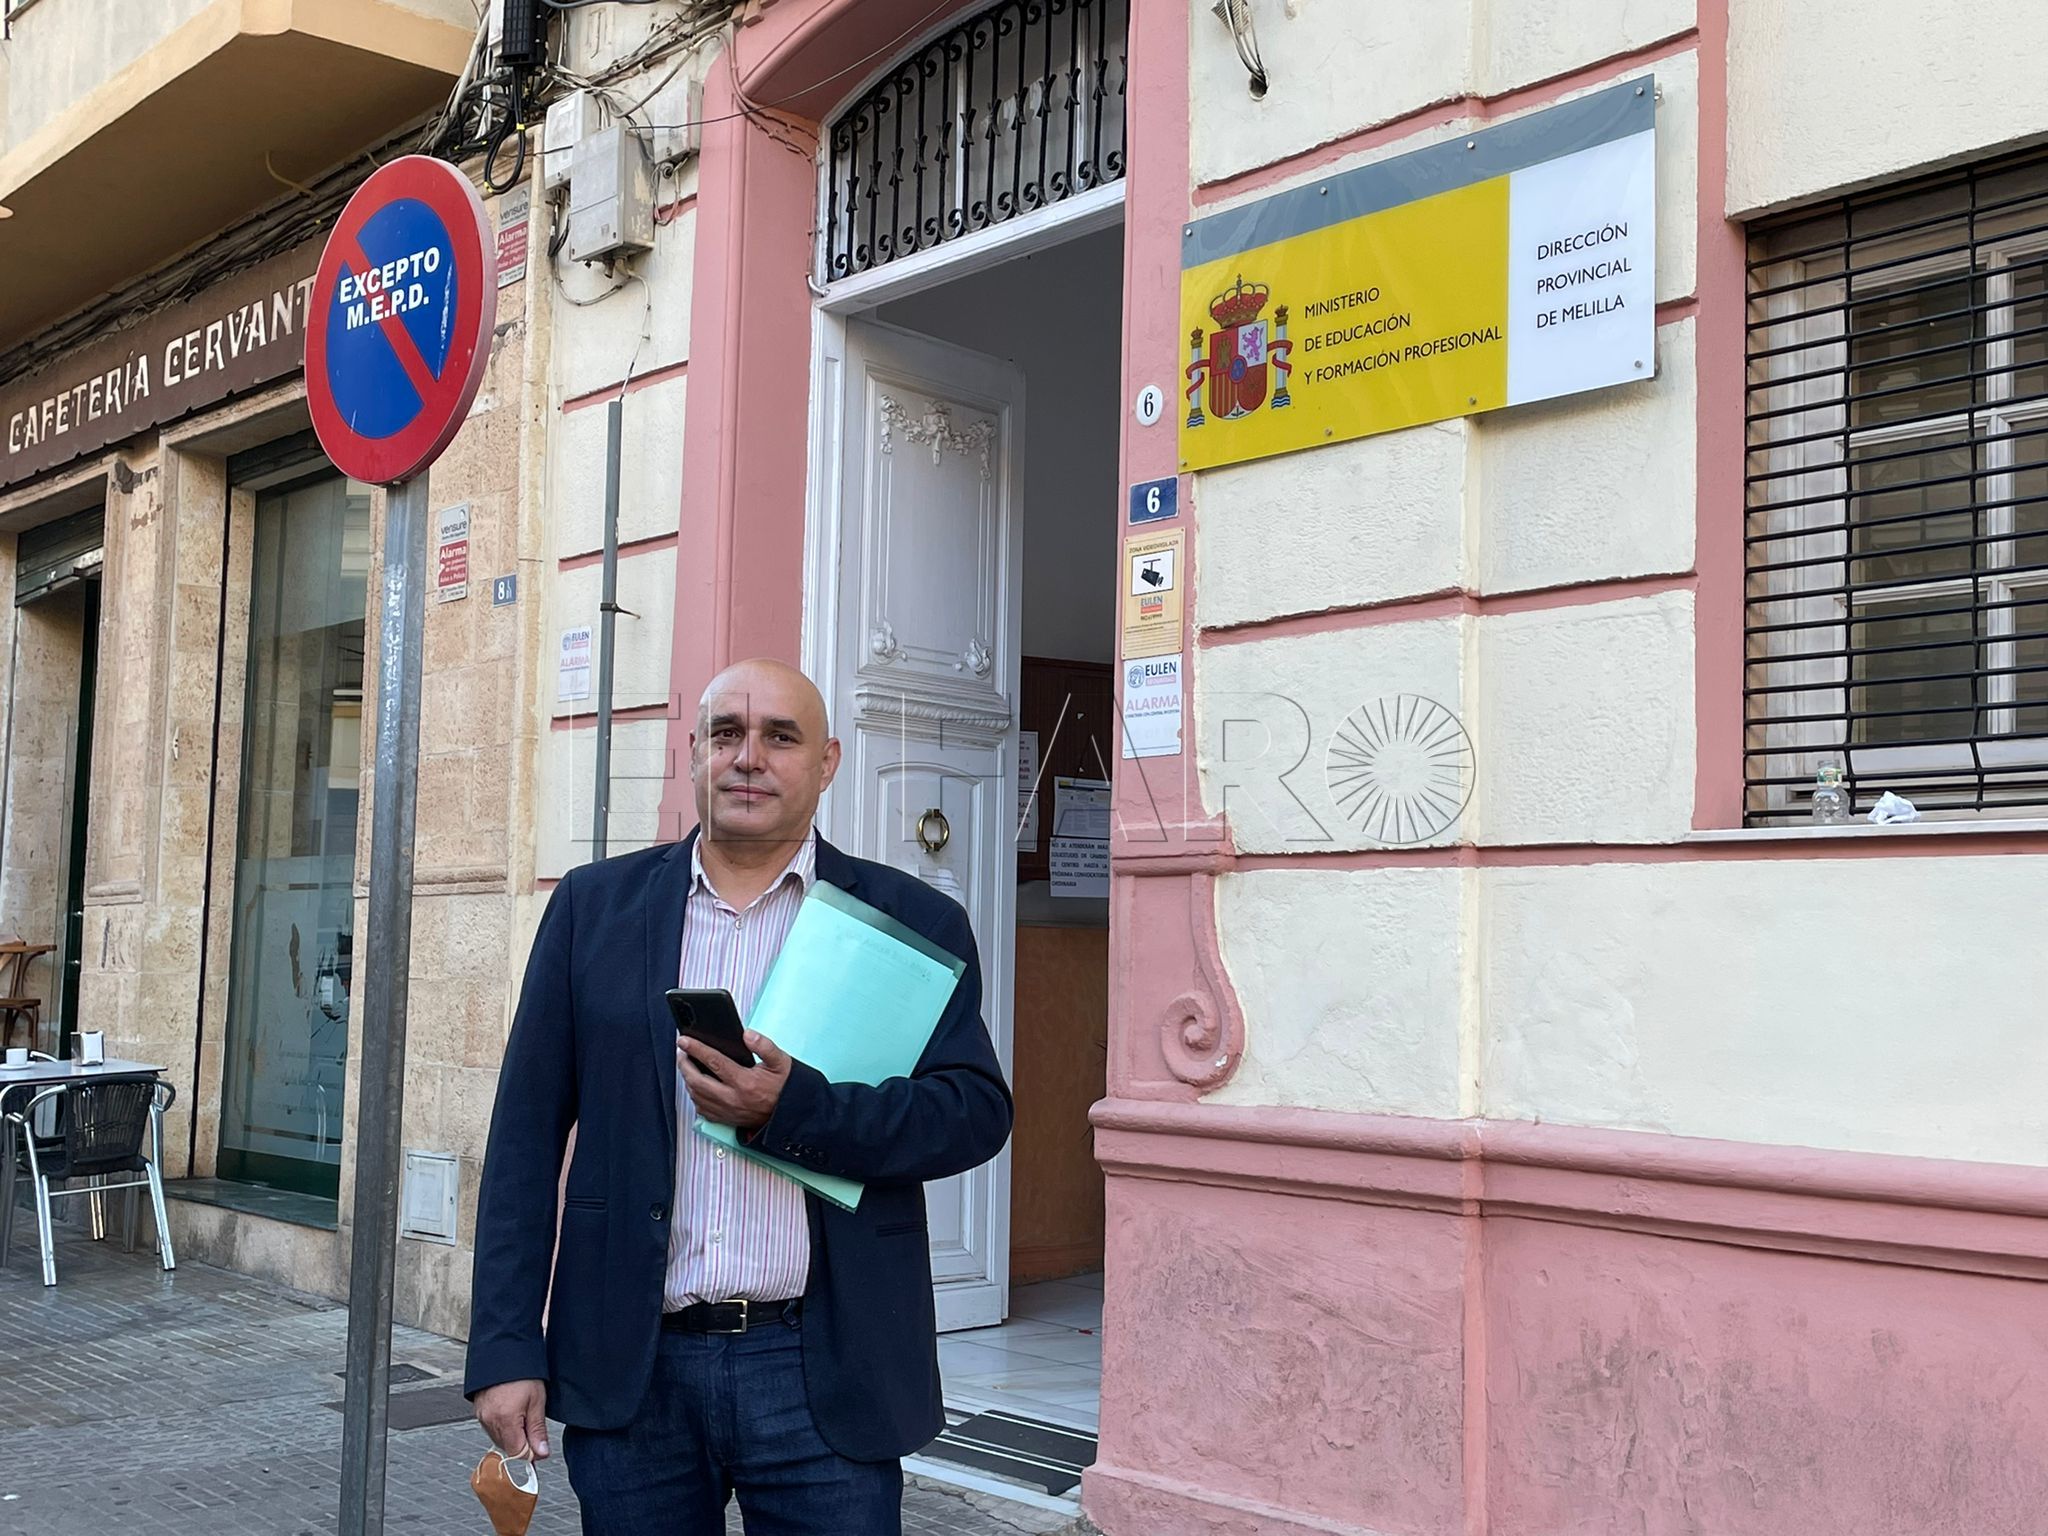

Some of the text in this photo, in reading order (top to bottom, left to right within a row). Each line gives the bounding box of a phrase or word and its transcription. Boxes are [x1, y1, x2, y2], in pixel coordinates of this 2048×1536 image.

[498, 227, 528, 245] Alarma
[1538, 222, 1628, 260] DIRECCIÓN
[340, 247, 440, 303] EXCEPTO
[1537, 257, 1632, 295] PROVINCIAL
[346, 283, 430, 330] M.E.P.D.
[1304, 287, 1380, 319] MINISTERIO
[1537, 294, 1625, 328] DE MELILLA
[1304, 313, 1411, 352] DE EDUCACIÓN
[1304, 325, 1503, 385] Y FORMACIÓN PROFESIONAL
[8, 350, 151, 455] CAFETERÍA
[1143, 392, 1154, 417] 6
[1146, 487, 1161, 513] 6
[440, 545, 467, 560] Alarma
[1129, 546, 1142, 554] ZONA
[1141, 595, 1163, 606] EULEN
[571, 631, 590, 642] EULEN
[560, 656, 590, 667] ALARMA
[1145, 662, 1177, 676] EULEN
[1125, 694, 1180, 712] ALARMA
